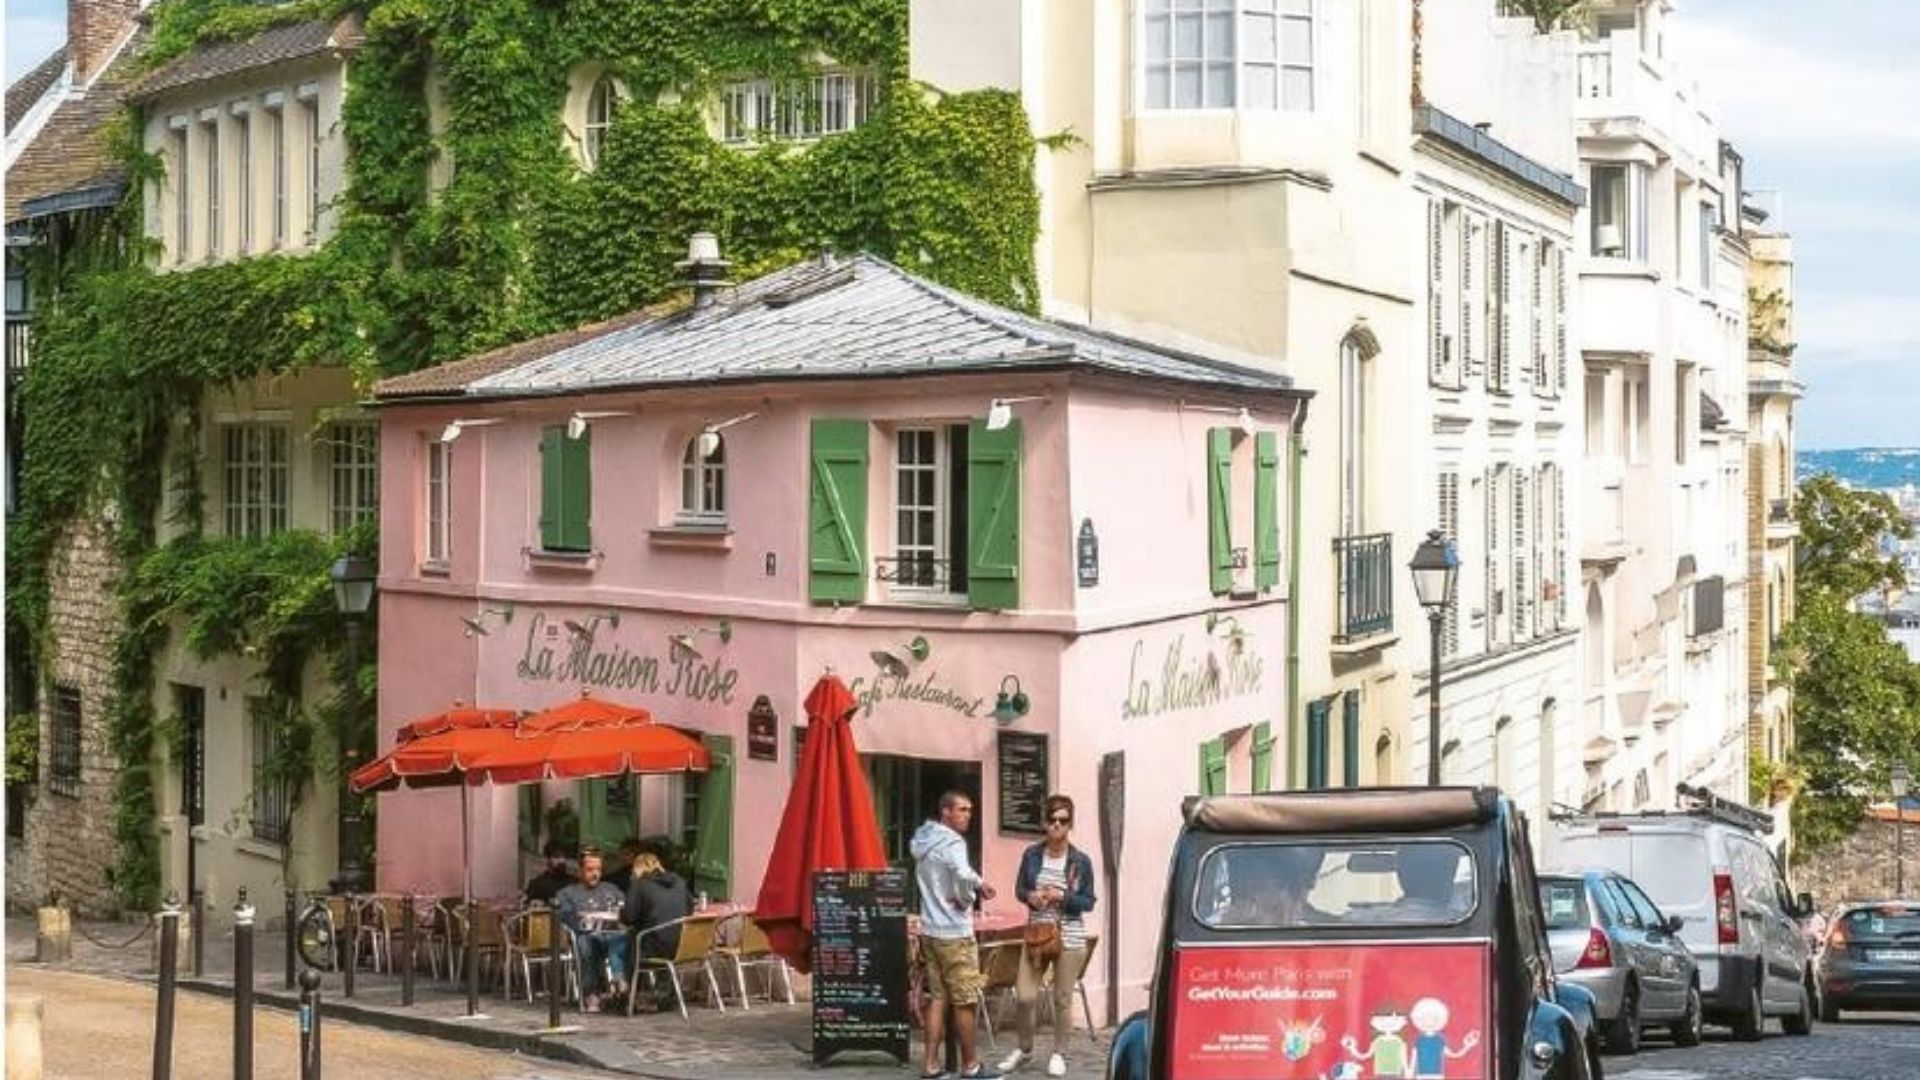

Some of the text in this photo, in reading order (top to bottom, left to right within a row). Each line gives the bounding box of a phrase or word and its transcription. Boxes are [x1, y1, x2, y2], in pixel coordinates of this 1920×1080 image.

[517, 612, 738, 703] La Maison Rose
[1122, 639, 1149, 720] La
[1155, 633, 1221, 715] Maison
[886, 672, 983, 718] Restaurant
[1188, 986, 1337, 1000] GetYourGuide.com
[1189, 967, 1218, 982] Get
